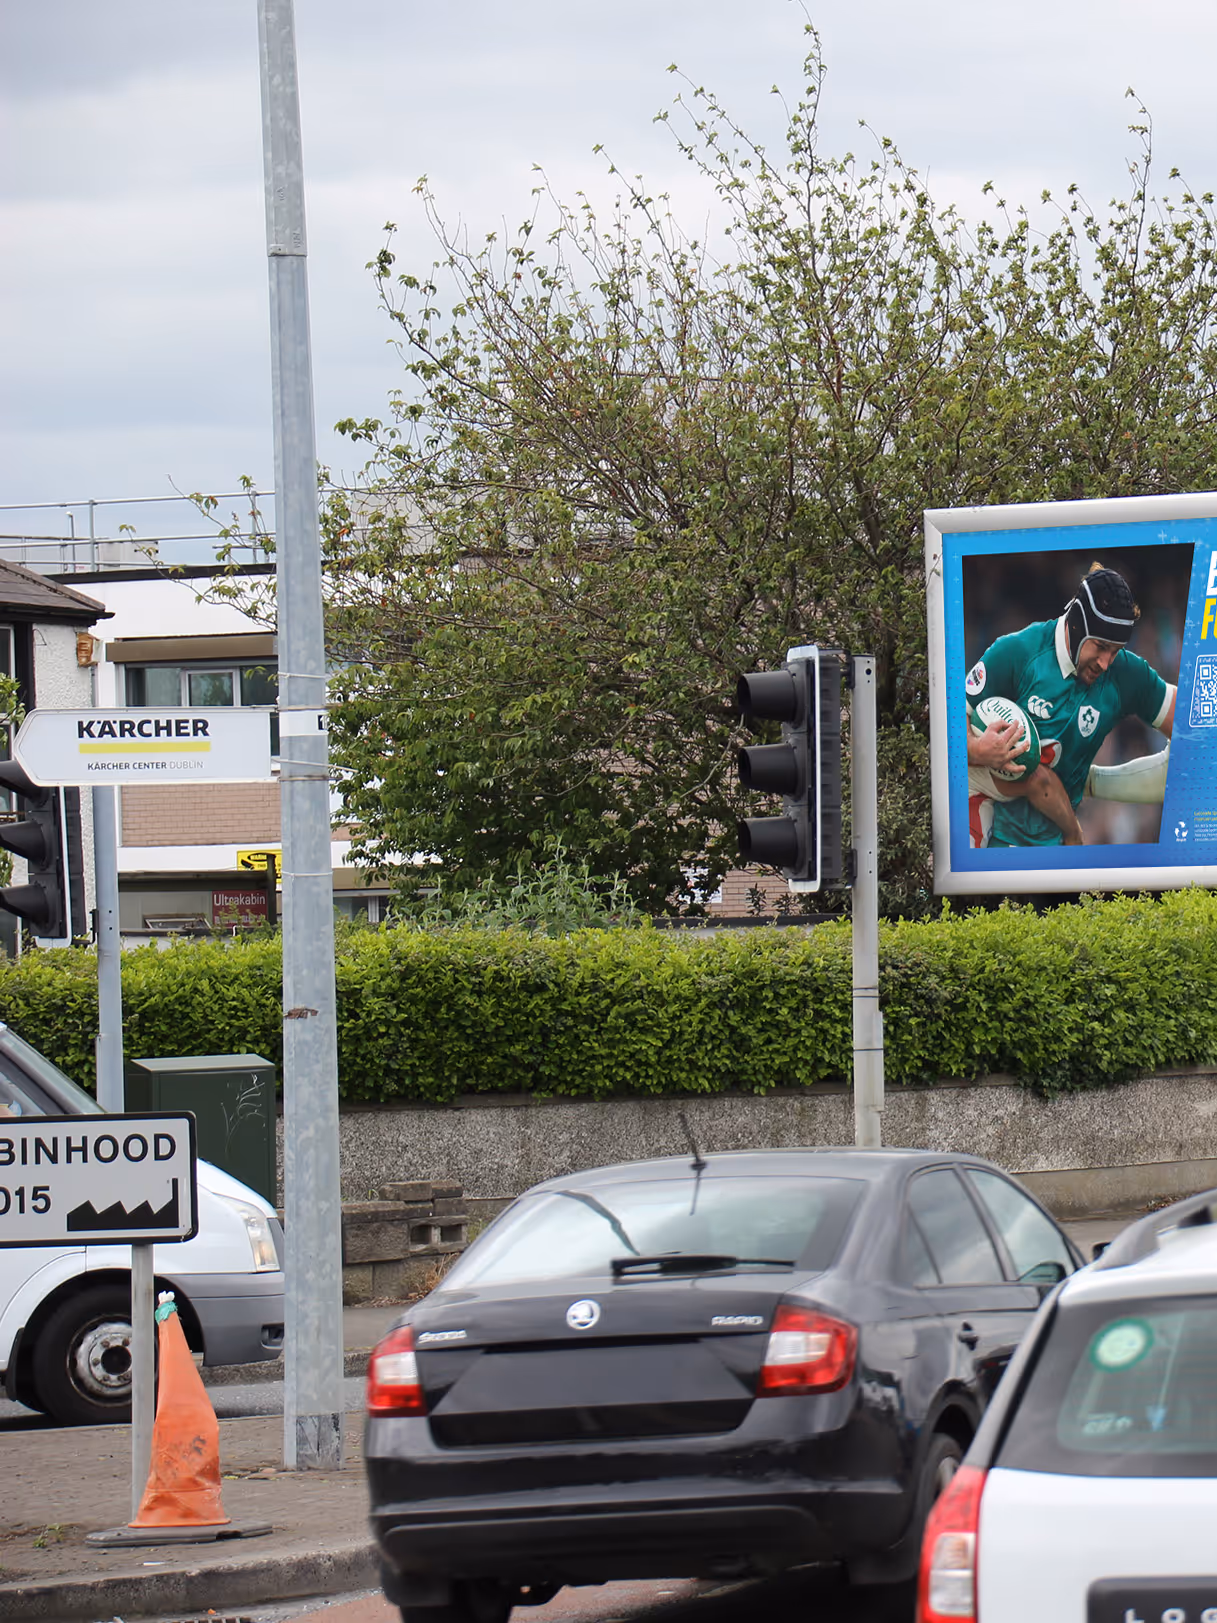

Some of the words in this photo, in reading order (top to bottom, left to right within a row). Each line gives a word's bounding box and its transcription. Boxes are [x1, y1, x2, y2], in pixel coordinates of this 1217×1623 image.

[77, 718, 210, 739] KÄRCHER
[87, 760, 131, 770] KÄRCHER
[132, 760, 167, 770] CENTER
[169, 760, 204, 770] DUBLIN
